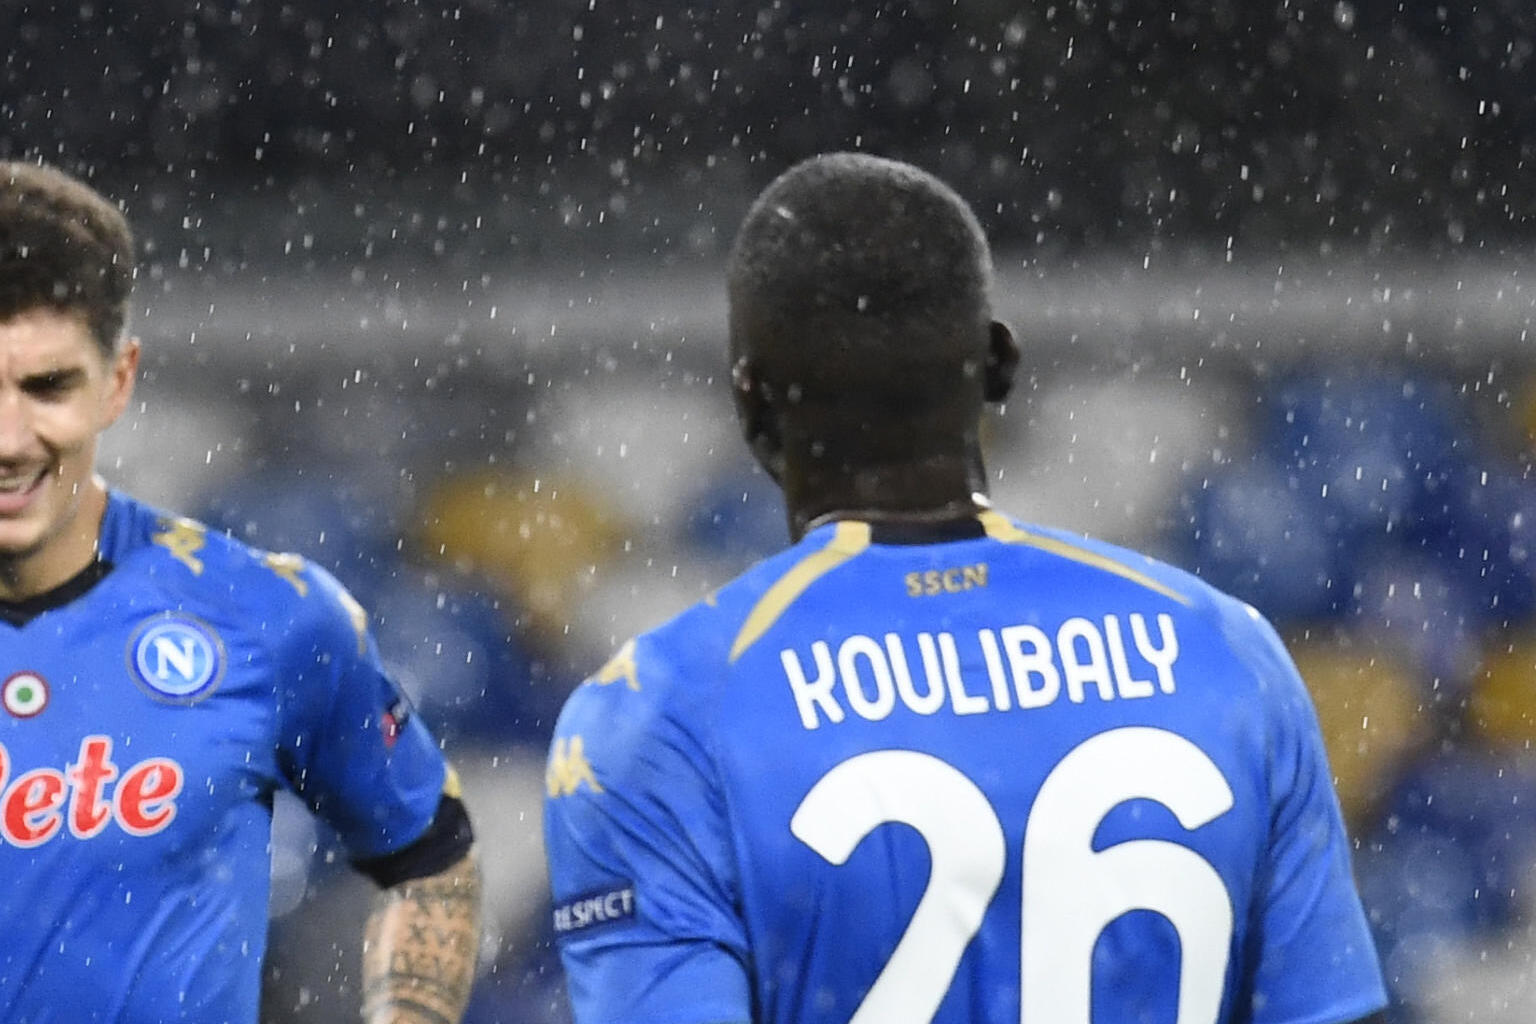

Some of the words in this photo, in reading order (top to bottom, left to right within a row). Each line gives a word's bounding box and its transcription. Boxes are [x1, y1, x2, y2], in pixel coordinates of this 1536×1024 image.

[906, 563, 987, 597] SSCN
[155, 637, 195, 681] N
[781, 613, 1179, 729] KOULIBALY
